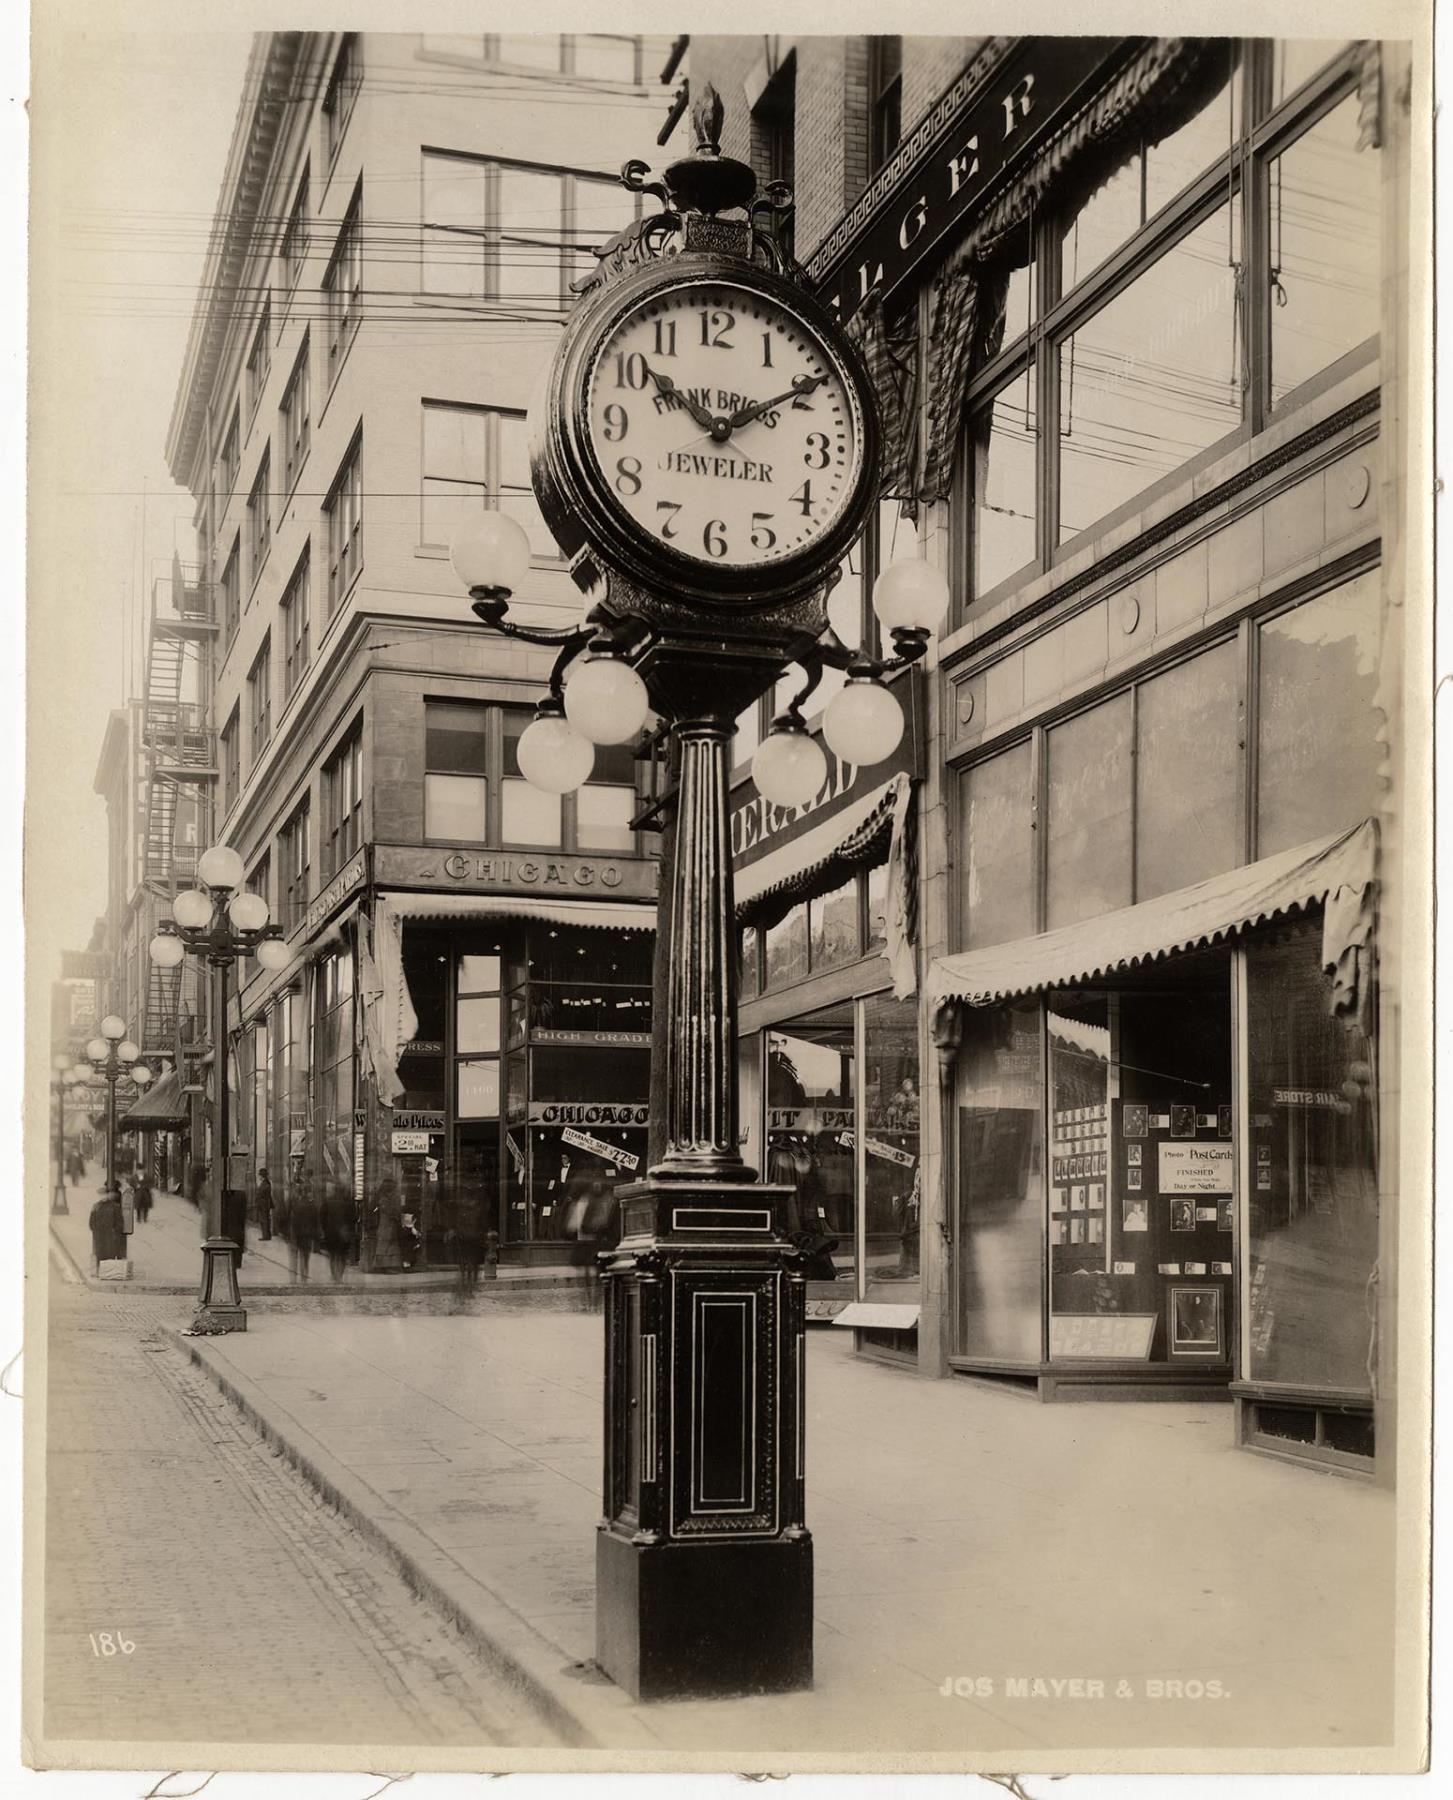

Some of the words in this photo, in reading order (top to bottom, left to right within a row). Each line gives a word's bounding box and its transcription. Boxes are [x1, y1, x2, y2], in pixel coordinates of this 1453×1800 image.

[653, 319, 677, 356] 11
[699, 311, 735, 348] 12
[761, 332, 774, 368] 1
[615, 352, 648, 390] 10
[652, 388, 712, 415] FRANK
[603, 404, 628, 441] 9
[658, 452, 773, 483] JEWELER
[805, 433, 830, 469] 3
[616, 457, 642, 495] 8
[788, 480, 816, 516] 4
[656, 501, 682, 538] 7
[751, 513, 776, 549] 5
[703, 520, 728, 557] 6
[444, 856, 622, 887] CHICAGO
[405, 1041, 441, 1051] RESS
[538, 1031, 580, 1040] HIGH
[543, 1105, 648, 1124] CHICAGO
[768, 1110, 800, 1127] IT
[1198, 1182, 1215, 1190] Night
